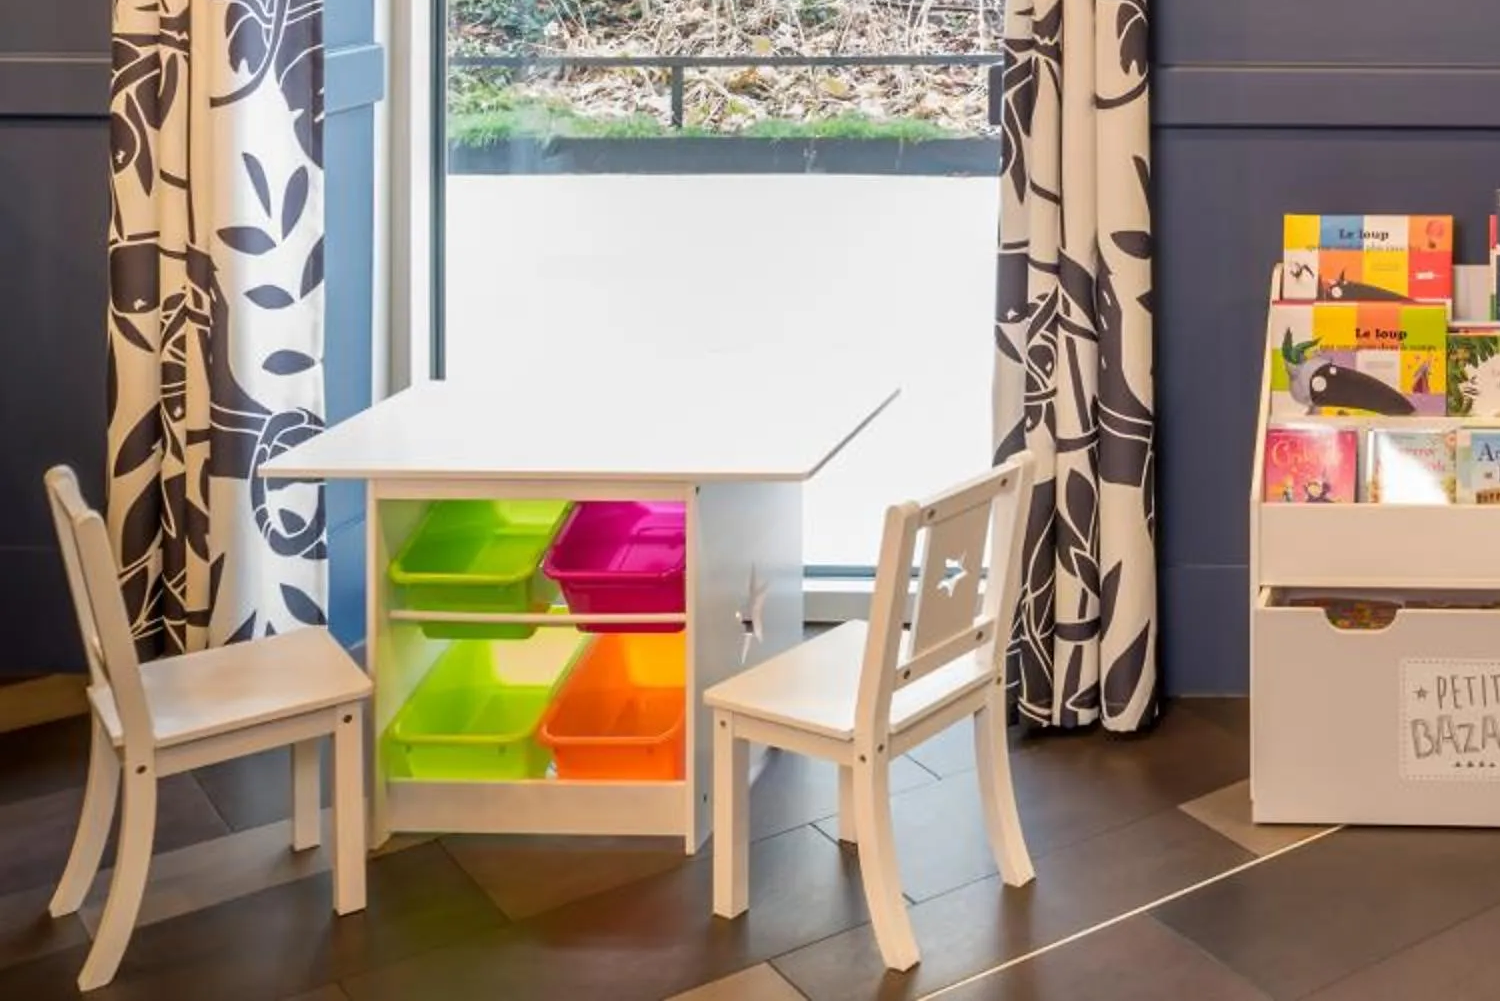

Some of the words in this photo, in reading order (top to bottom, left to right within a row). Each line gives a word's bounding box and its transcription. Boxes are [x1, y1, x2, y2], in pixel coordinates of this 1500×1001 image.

[1339, 229, 1355, 240] Le
[1359, 228, 1390, 242] loup
[1355, 327, 1371, 339] Le
[1375, 327, 1408, 342] loup
